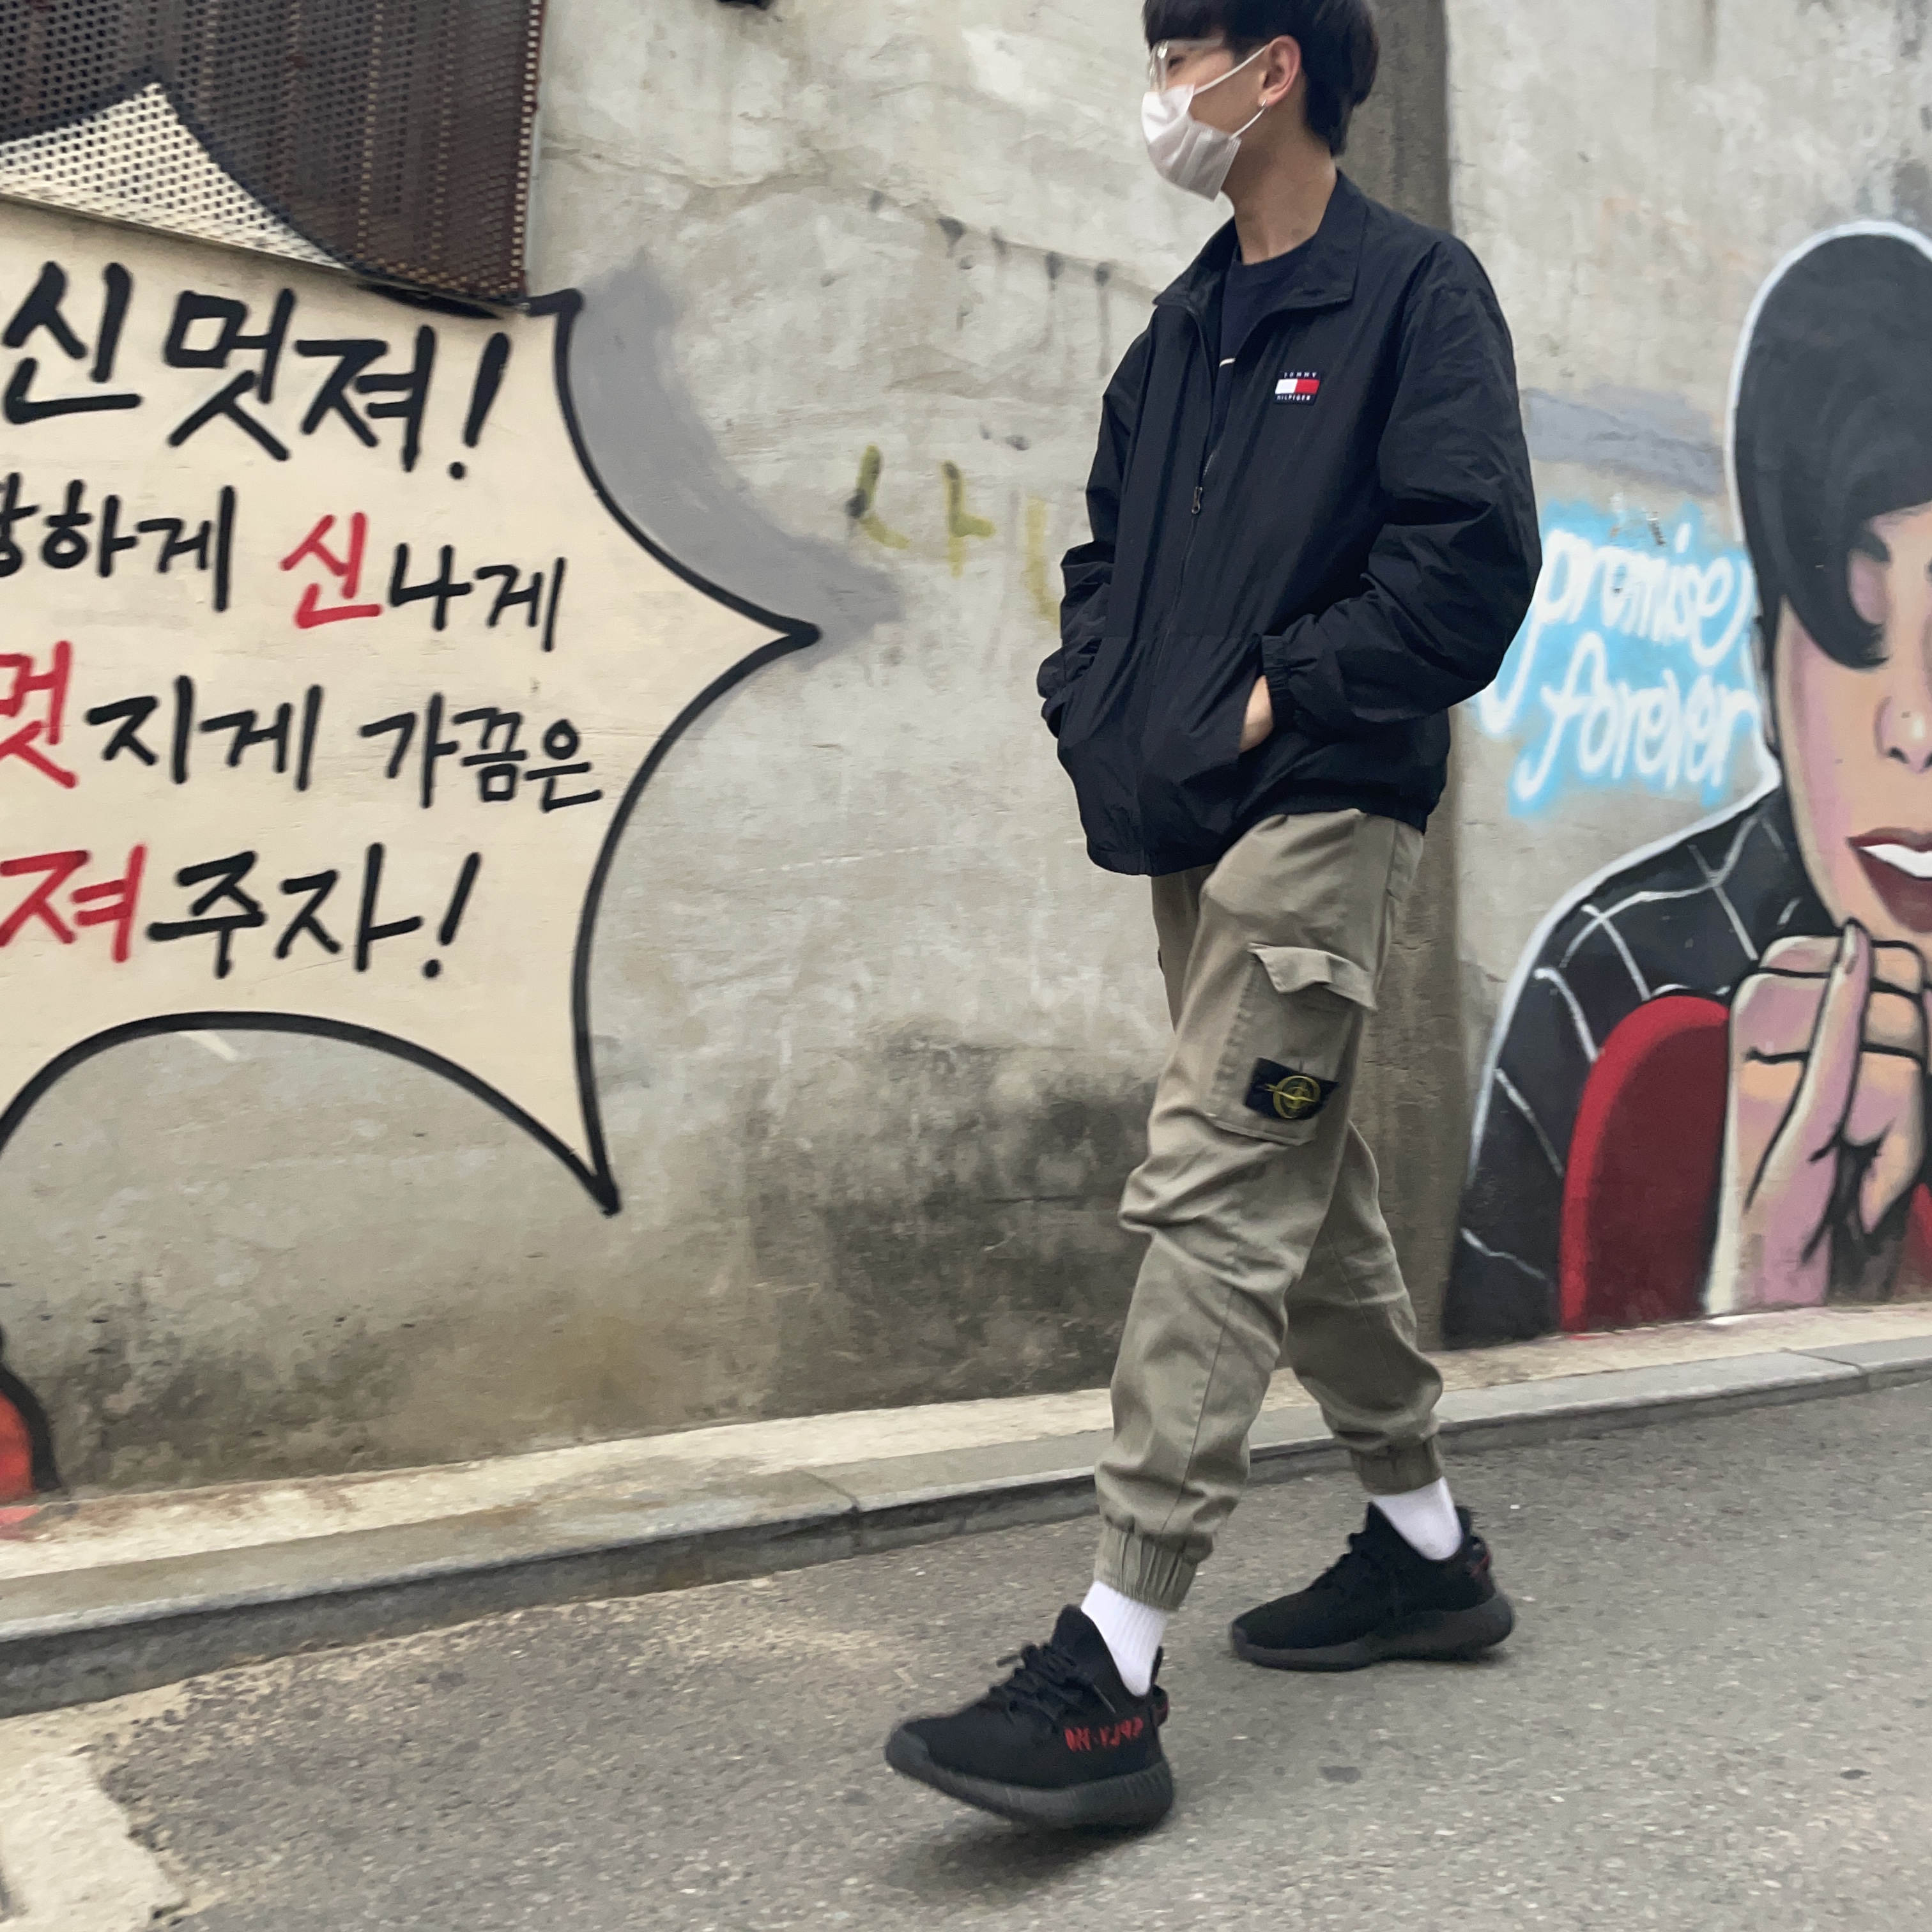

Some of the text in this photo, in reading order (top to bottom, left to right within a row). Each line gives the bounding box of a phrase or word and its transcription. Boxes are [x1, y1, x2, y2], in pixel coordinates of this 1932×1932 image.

[1, 260, 512, 480] 신 멋져!
[280, 511, 567, 653] 신나게
[1480, 522, 1751, 733] promise
[0, 640, 604, 814] 멋지게 가끔은
[0, 842, 482, 980] 져주자!
